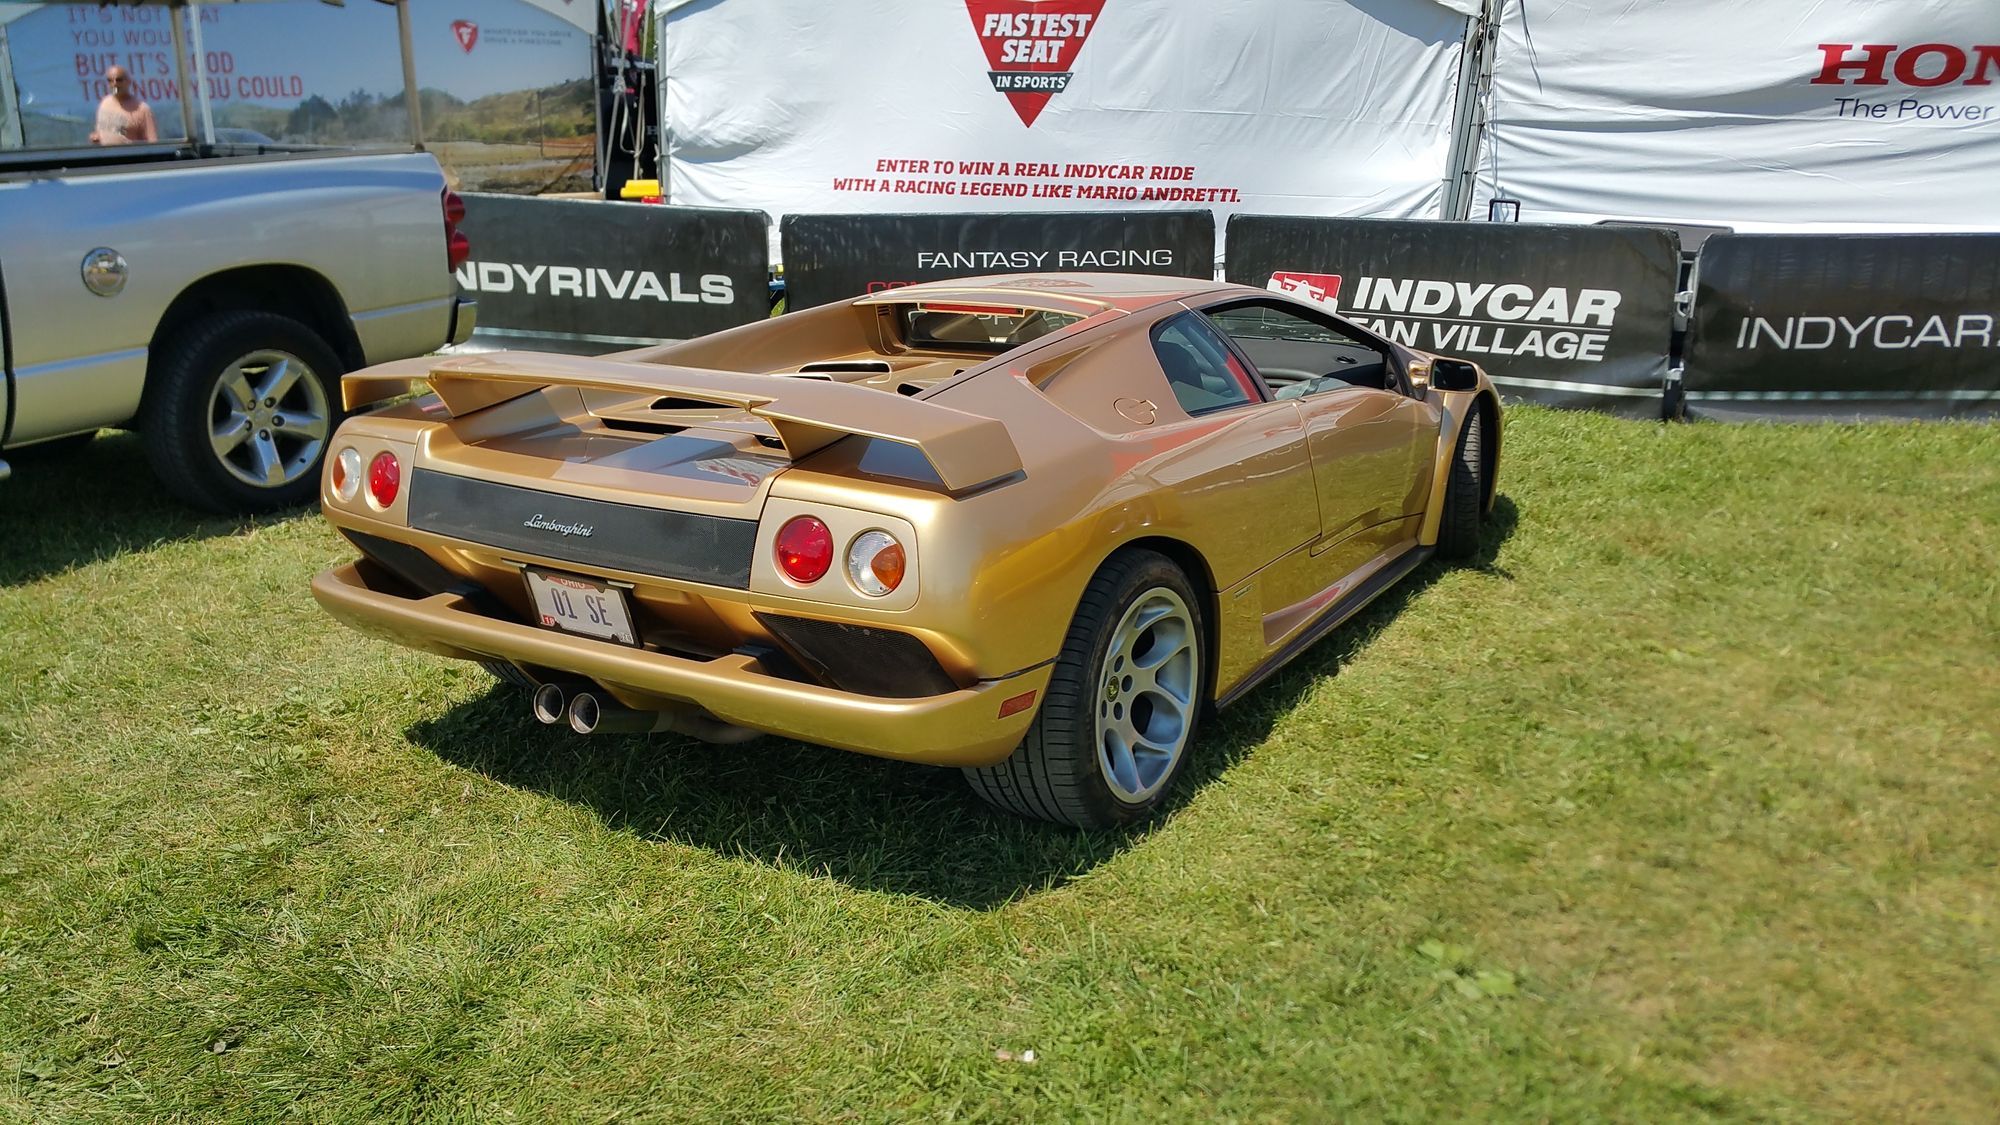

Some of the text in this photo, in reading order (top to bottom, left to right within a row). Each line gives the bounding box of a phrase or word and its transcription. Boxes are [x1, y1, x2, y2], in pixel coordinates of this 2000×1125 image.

[122, 7, 161, 23] NOT
[982, 13, 1092, 37] FASTEST
[72, 29, 197, 46] YOU WOUD
[1000, 39, 1065, 63] SEAT
[76, 52, 117, 76] BUT
[127, 52, 170, 76] IT'S
[130, 78, 181, 100] NOW
[237, 75, 303, 97] COULD
[996, 75, 1066, 89] IN SPORTS
[1834, 98, 1994, 120] The Power
[876, 159, 1195, 180] ENTER TO WIN A REAL INDYCAR RIDE
[833, 178, 1241, 203] WITH A RACING LEGEND LIKE MARIO ANDRETTI.
[917, 249, 1173, 269] FANTASY RACING
[456, 261, 735, 305] NDYRIVALS
[1352, 276, 1622, 327] INDYCAR
[1432, 323, 1610, 362] VILLAGE
[1736, 314, 2000, 350] INDYCAR
[523, 513, 594, 538] Lamborghini
[585, 594, 613, 627] SE
